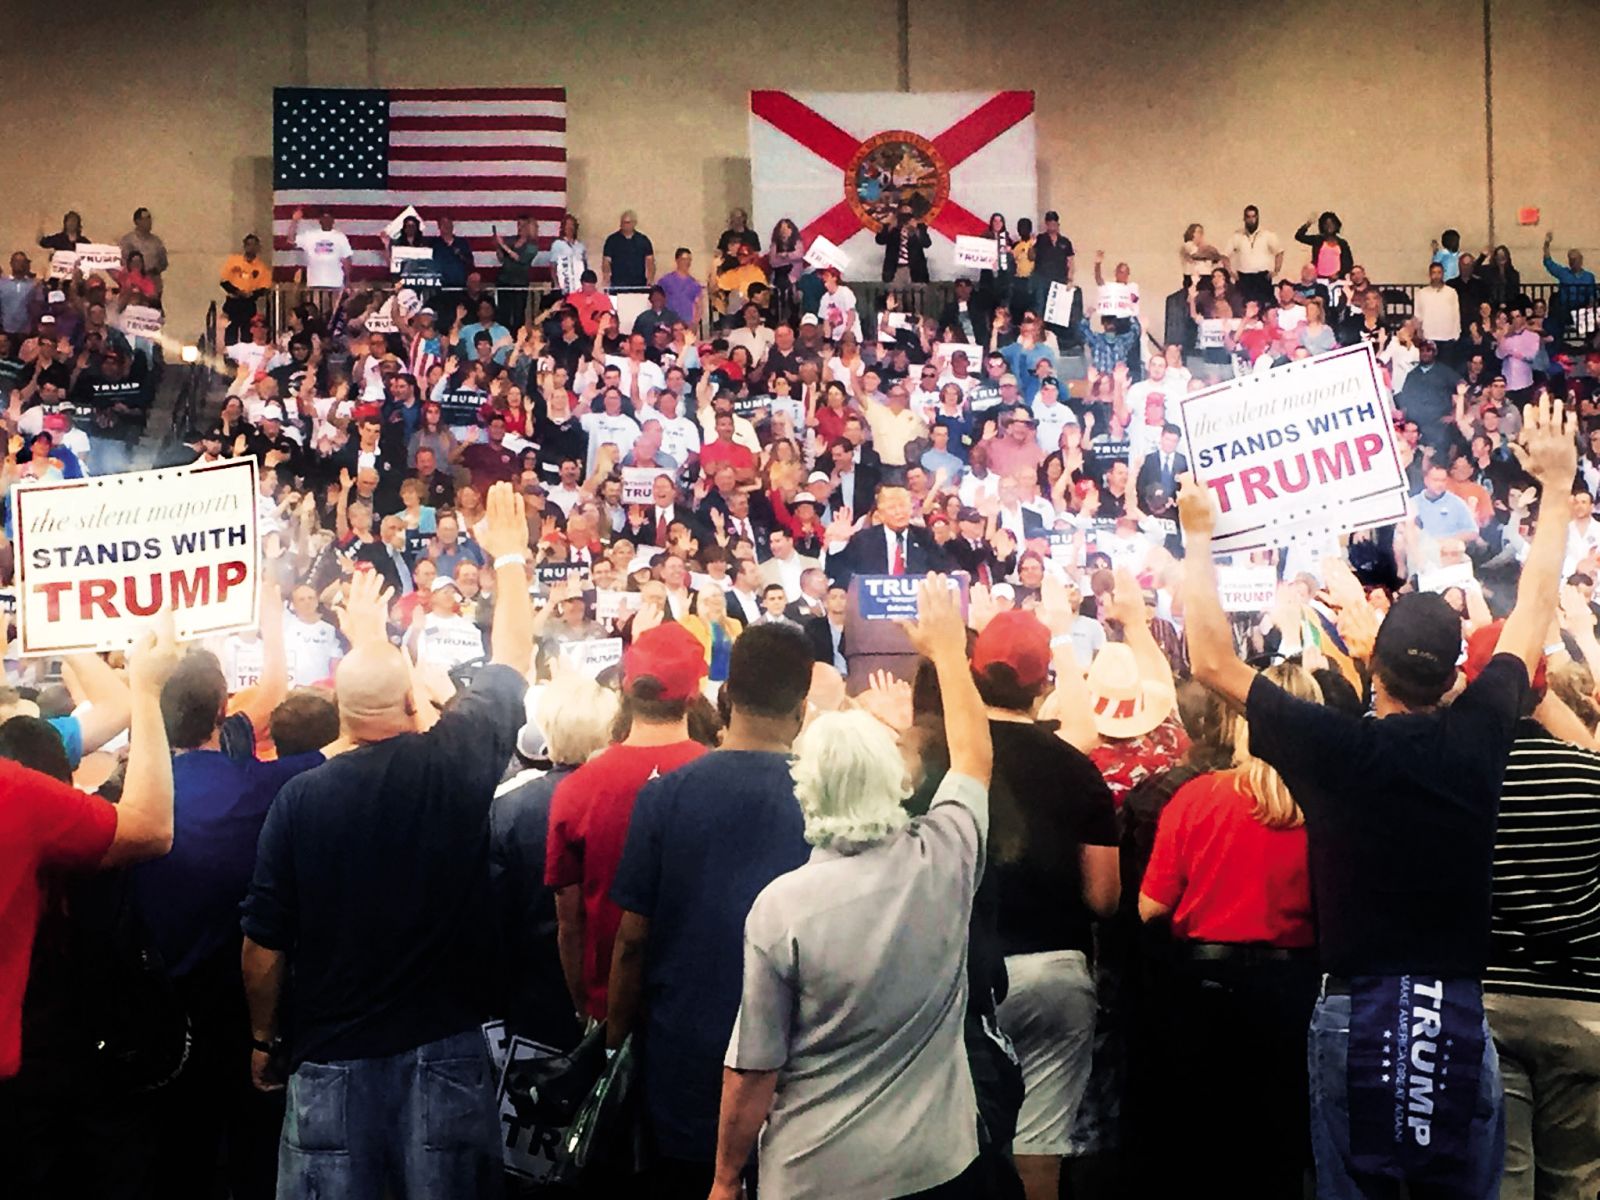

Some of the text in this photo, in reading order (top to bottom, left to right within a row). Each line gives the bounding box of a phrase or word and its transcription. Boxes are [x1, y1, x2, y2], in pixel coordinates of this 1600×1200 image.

[92, 382, 140, 391] TRUMP
[970, 388, 1002, 400] TRU
[734, 398, 772, 410] RUMP
[1199, 402, 1376, 468] STANDS WITH
[1094, 445, 1130, 454] TRUM
[1207, 432, 1385, 514] TRUMP
[625, 488, 653, 498] TRU
[30, 493, 239, 533] the silent majority
[32, 524, 247, 569] STANDS WITH
[411, 537, 467, 548] TRP
[32, 560, 248, 623] TRUMP
[865, 578, 960, 597] TRUP
[1224, 591, 1273, 603] TRUMP
[238, 674, 294, 687] TRP
[1407, 979, 1443, 1146] TRUMP
